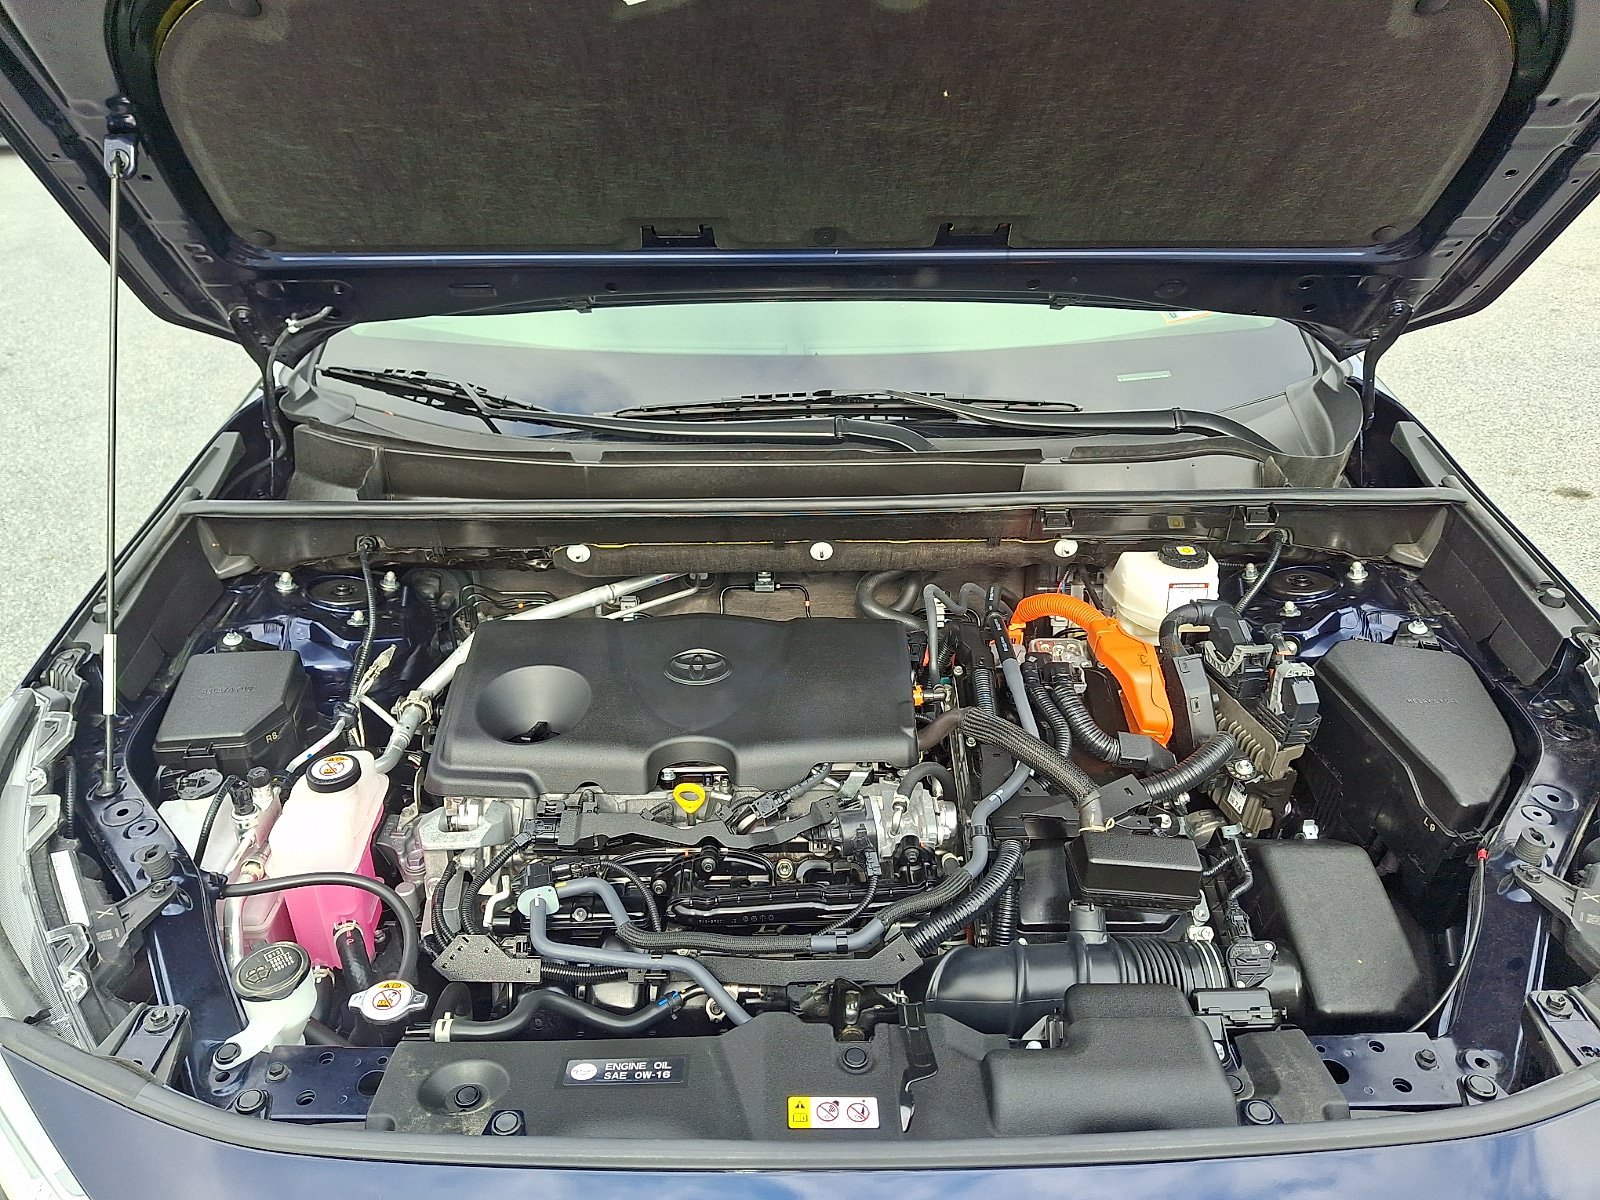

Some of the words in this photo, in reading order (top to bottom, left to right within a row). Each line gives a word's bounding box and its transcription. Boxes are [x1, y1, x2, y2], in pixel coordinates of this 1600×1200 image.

[605, 1061, 648, 1071] ENGINE
[653, 1061, 672, 1070] OIL
[603, 1071, 628, 1080] SAE
[634, 1070, 671, 1080] 0W-16
